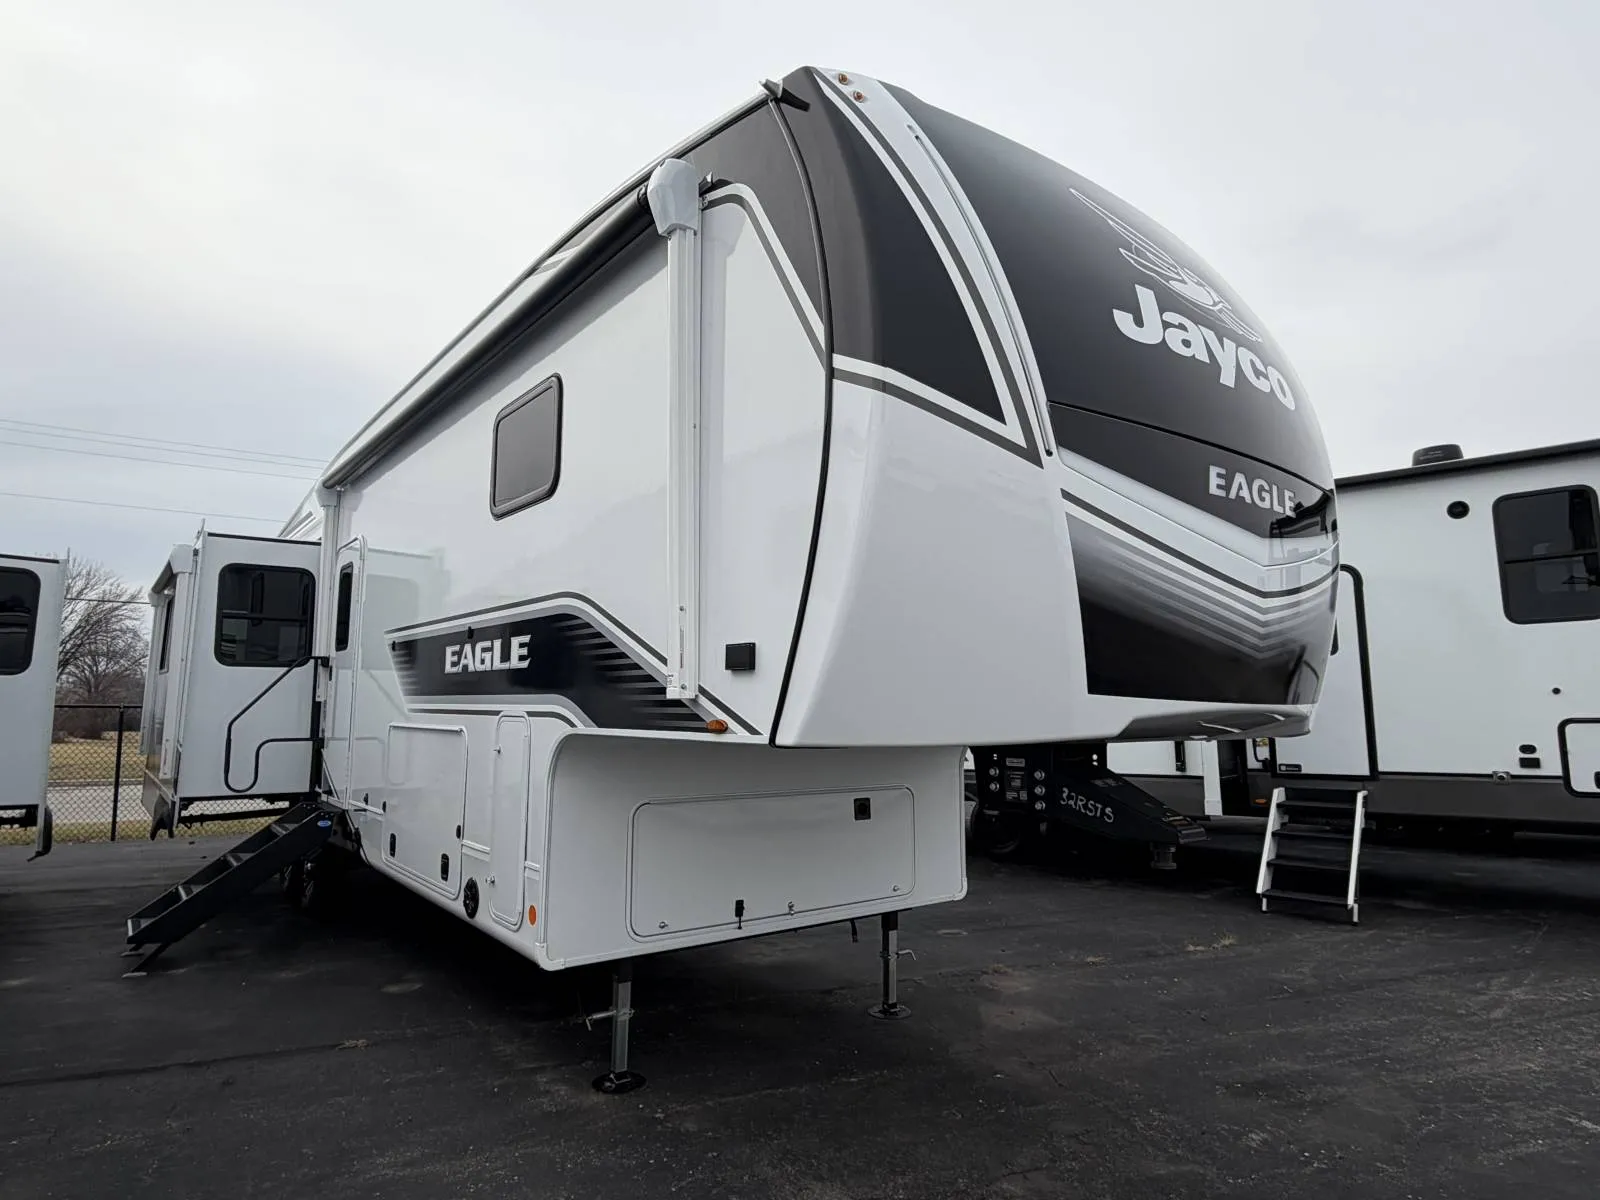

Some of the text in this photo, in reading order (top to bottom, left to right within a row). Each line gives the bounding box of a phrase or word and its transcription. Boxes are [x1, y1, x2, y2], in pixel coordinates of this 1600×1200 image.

[1112, 284, 1296, 411] Jayco
[1208, 465, 1297, 518] EAGLE
[444, 634, 532, 674] EAGLE
